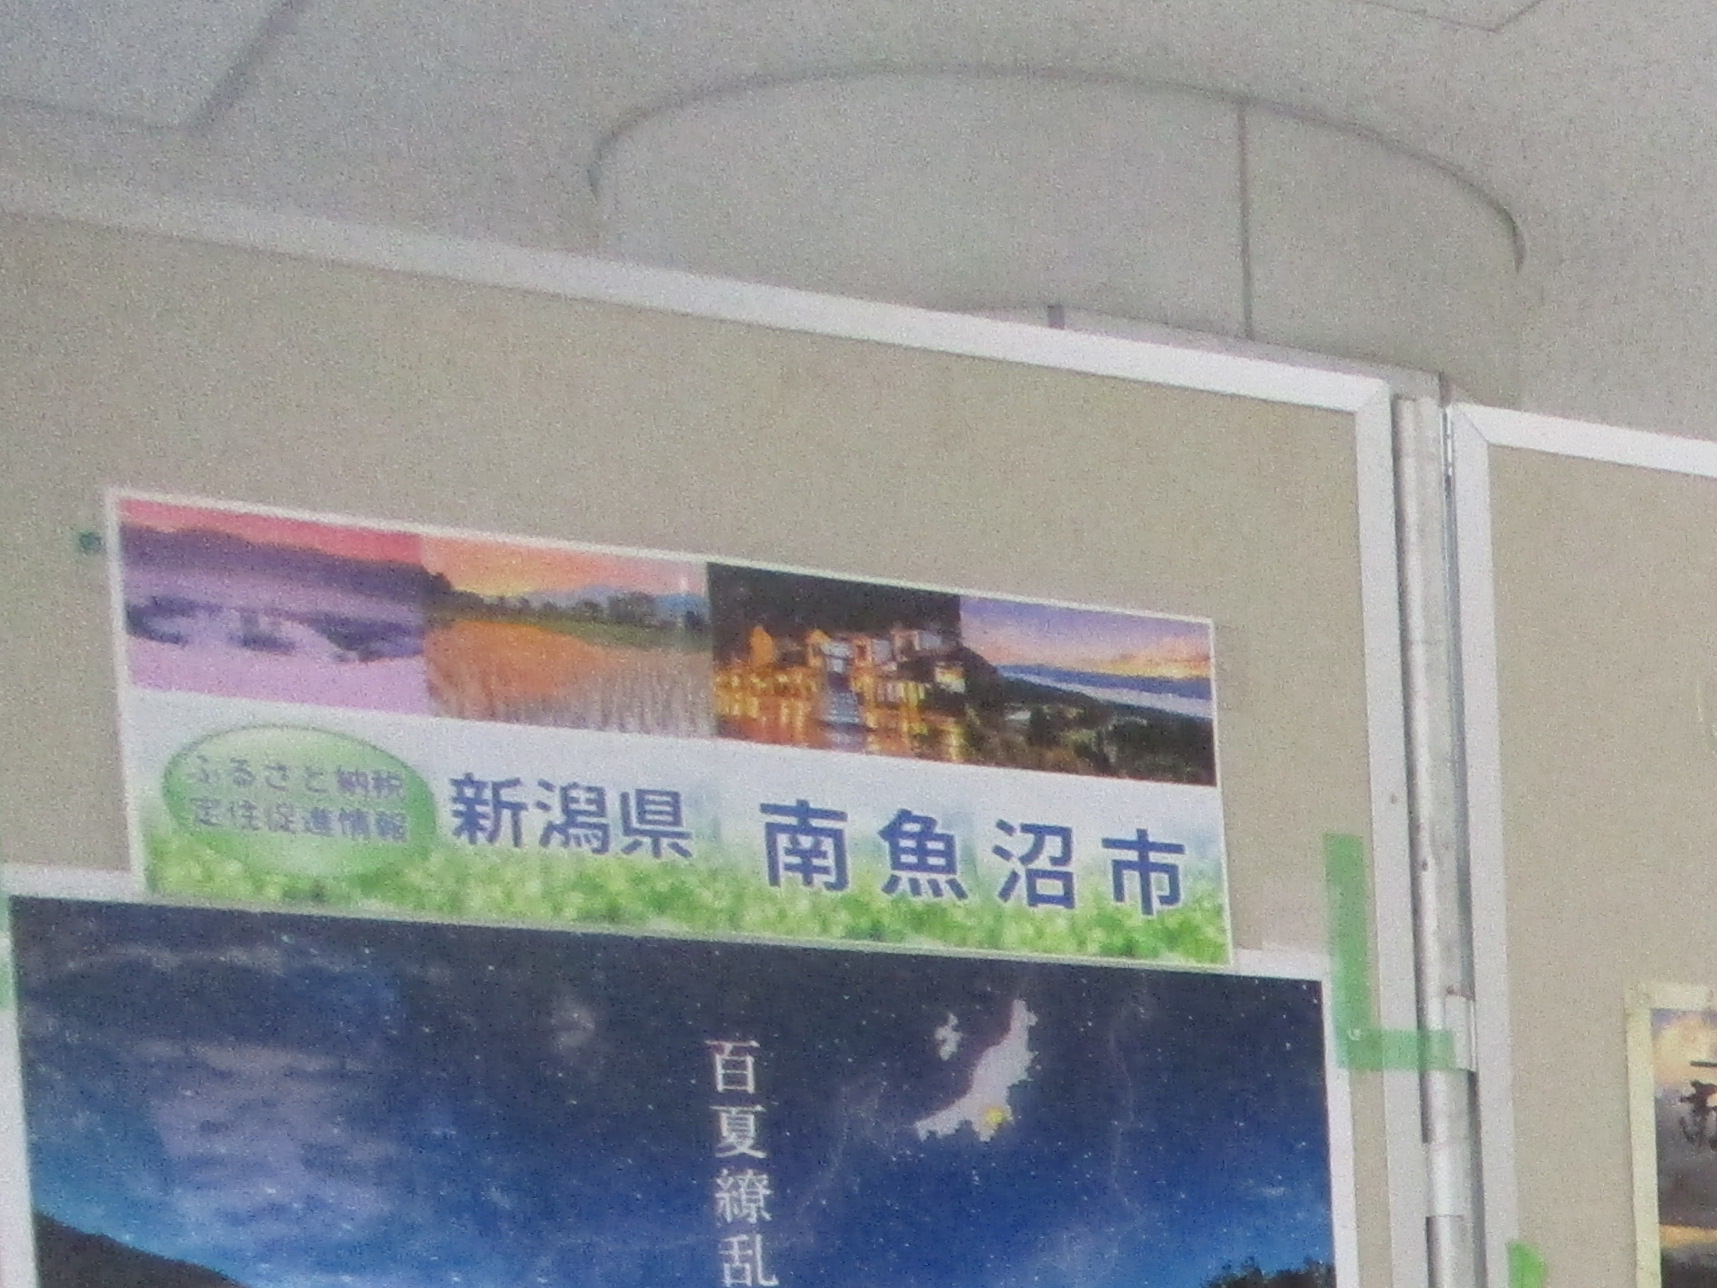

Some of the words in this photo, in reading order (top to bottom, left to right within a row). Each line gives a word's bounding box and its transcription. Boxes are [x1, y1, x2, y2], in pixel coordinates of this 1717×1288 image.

[449, 771, 696, 861] 新潟県
[760, 799, 1188, 919] 南魚沼市
